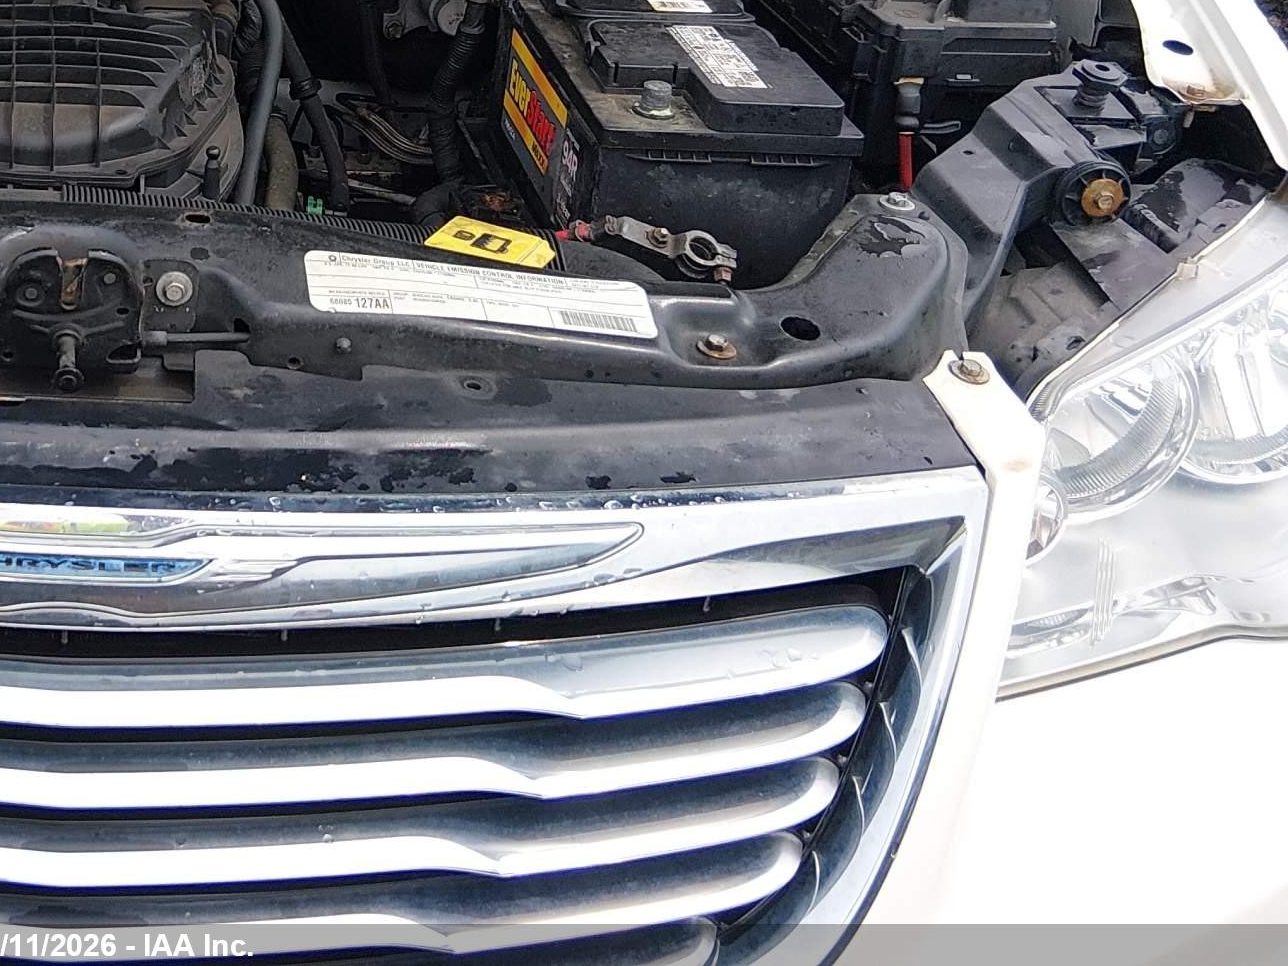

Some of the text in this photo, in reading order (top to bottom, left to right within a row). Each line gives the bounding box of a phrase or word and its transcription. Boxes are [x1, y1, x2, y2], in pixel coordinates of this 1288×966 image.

[509, 58, 557, 156] EverStart
[341, 255, 371, 264] Chrysler
[373, 258, 395, 267] Group
[416, 262, 445, 272] VEHICLE
[447, 264, 480, 275] EMISSION
[482, 269, 514, 279] CONTROL
[515, 273, 564, 285] INFORMATION
[355, 297, 390, 309] 127AA
